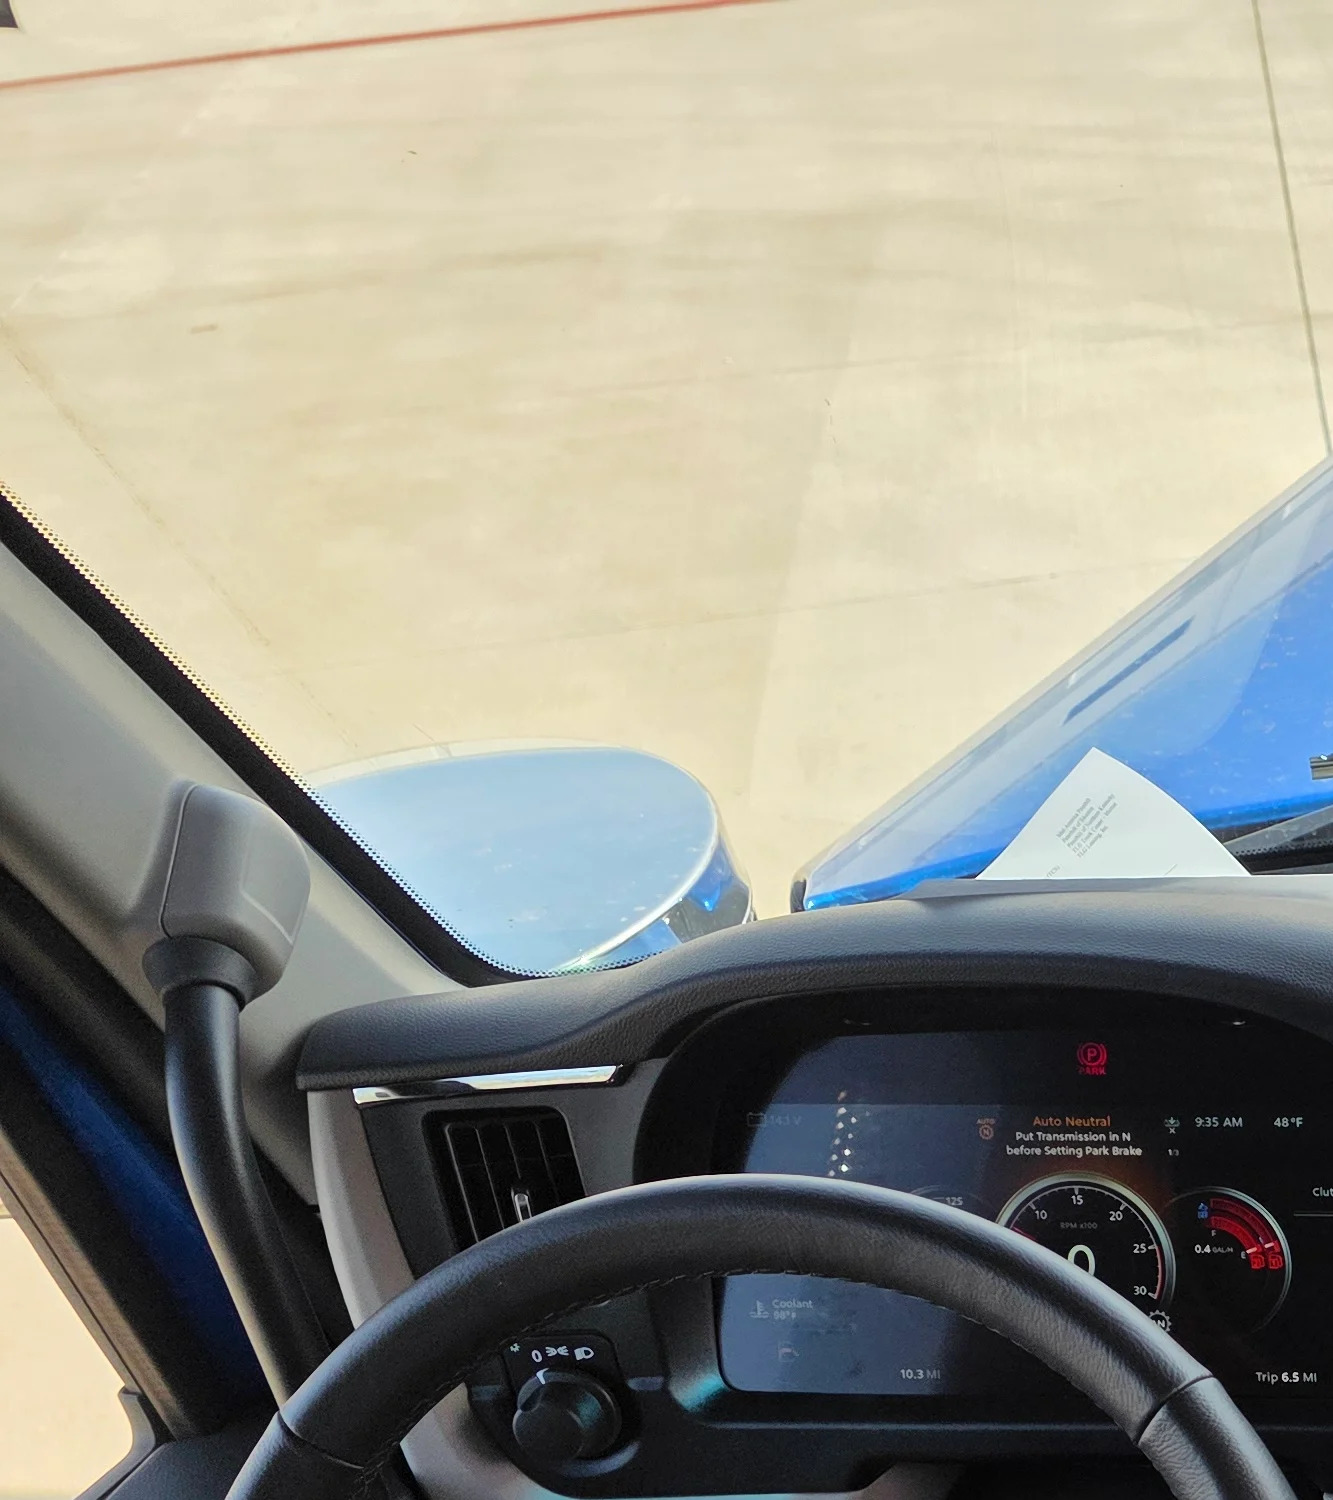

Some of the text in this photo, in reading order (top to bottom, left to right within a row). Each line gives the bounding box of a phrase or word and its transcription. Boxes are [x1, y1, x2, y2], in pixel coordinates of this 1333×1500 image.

[1078, 1067, 1106, 1075] PARK
[1033, 1116, 1111, 1127] Auto Neutral
[1195, 1117, 1243, 1128] 9:35 AM
[1015, 1131, 1131, 1142] Put Transmission in N
[1006, 1145, 1143, 1158] before Setting Park Brake
[1071, 1195, 1084, 1206] 15
[1035, 1210, 1047, 1220] 10
[1109, 1211, 1123, 1221] 20
[1133, 1244, 1147, 1254] 25
[1194, 1245, 1211, 1254] 0.4
[1133, 1286, 1147, 1295] 30
[772, 1298, 812, 1310] Coolant
[900, 1369, 941, 1380] 10.3 MI
[1256, 1372, 1317, 1384] Trip 6.5 MI
